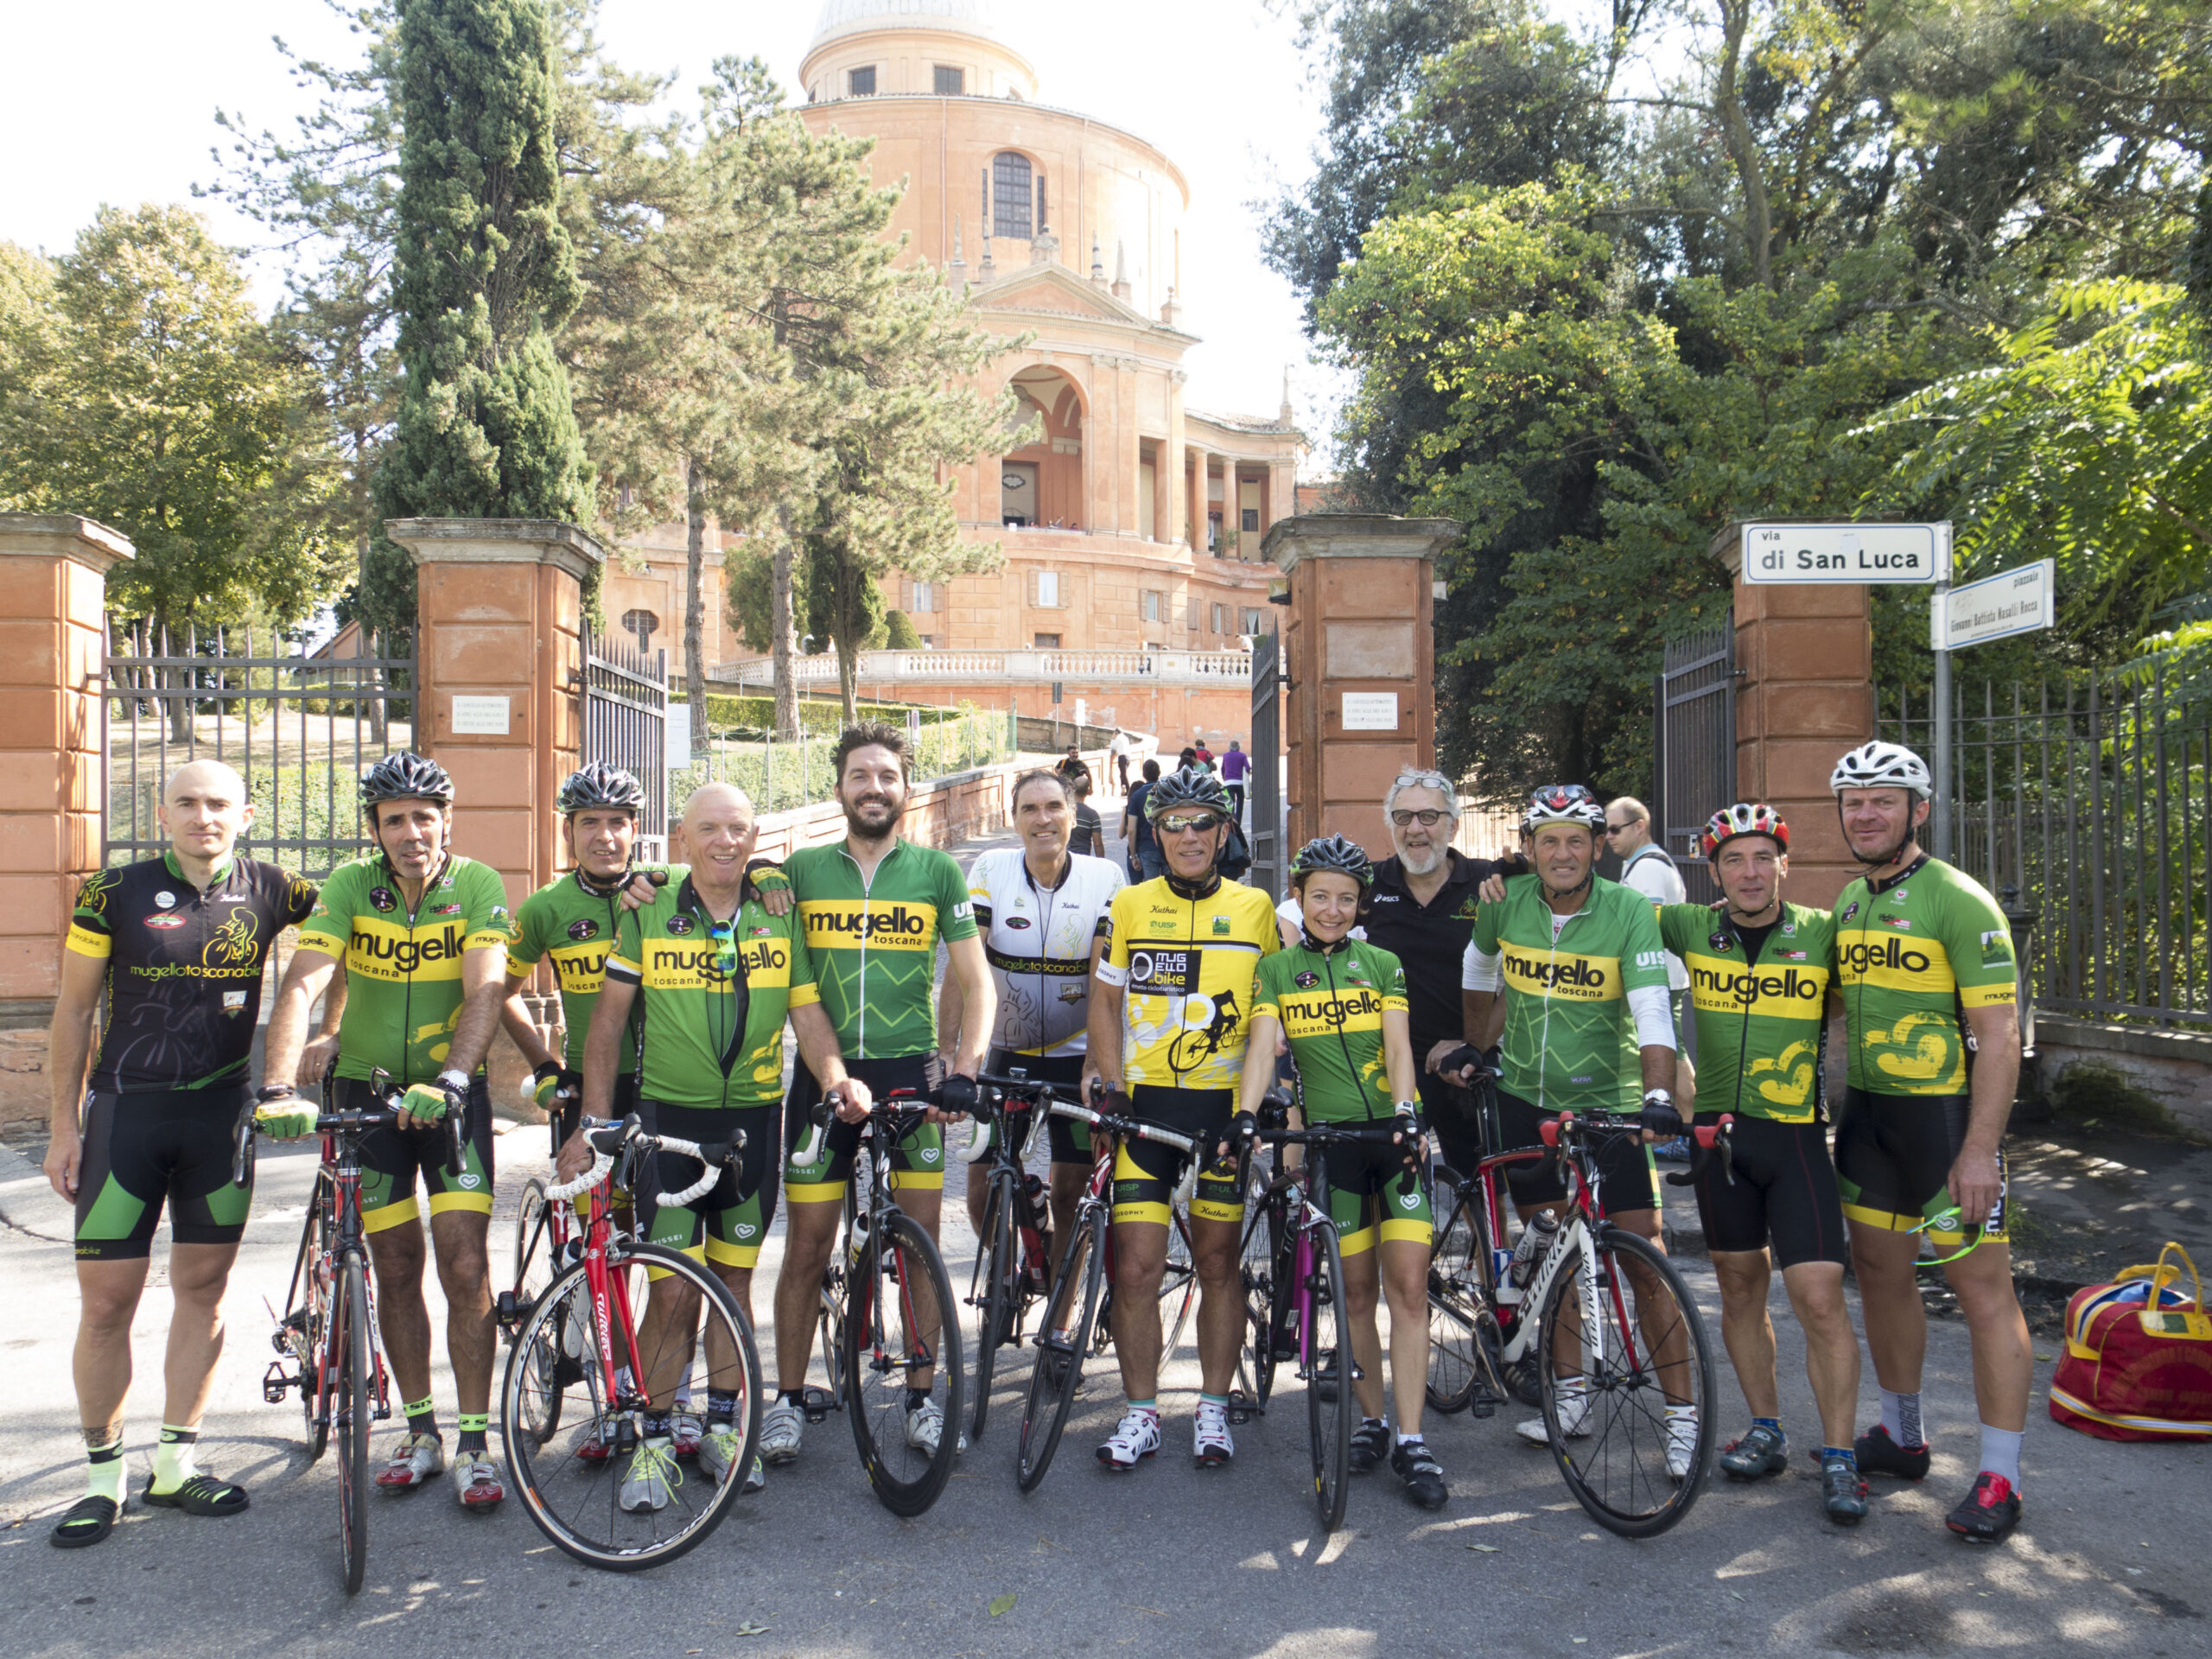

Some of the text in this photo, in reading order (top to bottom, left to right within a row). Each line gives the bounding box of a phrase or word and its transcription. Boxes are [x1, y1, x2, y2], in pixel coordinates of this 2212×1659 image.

[1762, 531, 1781, 541] via
[1762, 549, 1920, 570] di San Luca
[2013, 570, 2039, 589] piazzale
[1950, 618, 1973, 632] Giovanni
[1974, 610, 1997, 626] Battista
[1998, 604, 2019, 620] Nasalli
[2020, 601, 2038, 614] Rocca
[1149, 905, 1179, 915] Kuthai
[809, 906, 924, 940] mugello
[874, 934, 922, 946] toscana
[1636, 950, 1667, 968] UIS
[1837, 937, 1930, 974] ugello
[130, 961, 261, 982] mugellotoscanabike
[350, 958, 400, 979] toscana
[1505, 954, 1605, 988] mugello
[653, 976, 702, 986] toscana
[1154, 972, 1186, 986] bike
[1693, 968, 1818, 1005] mugello
[1147, 984, 1185, 993] cicloturistico
[1557, 985, 1604, 998] toscana
[1695, 995, 1739, 1009] toscana
[1288, 1024, 1332, 1035] toscana
[1200, 1206, 1230, 1218] Kuthai
[652, 1234, 683, 1245] PISSEI
[322, 1281, 335, 1356] SCOTT
[365, 1280, 378, 1352] SCOTT
